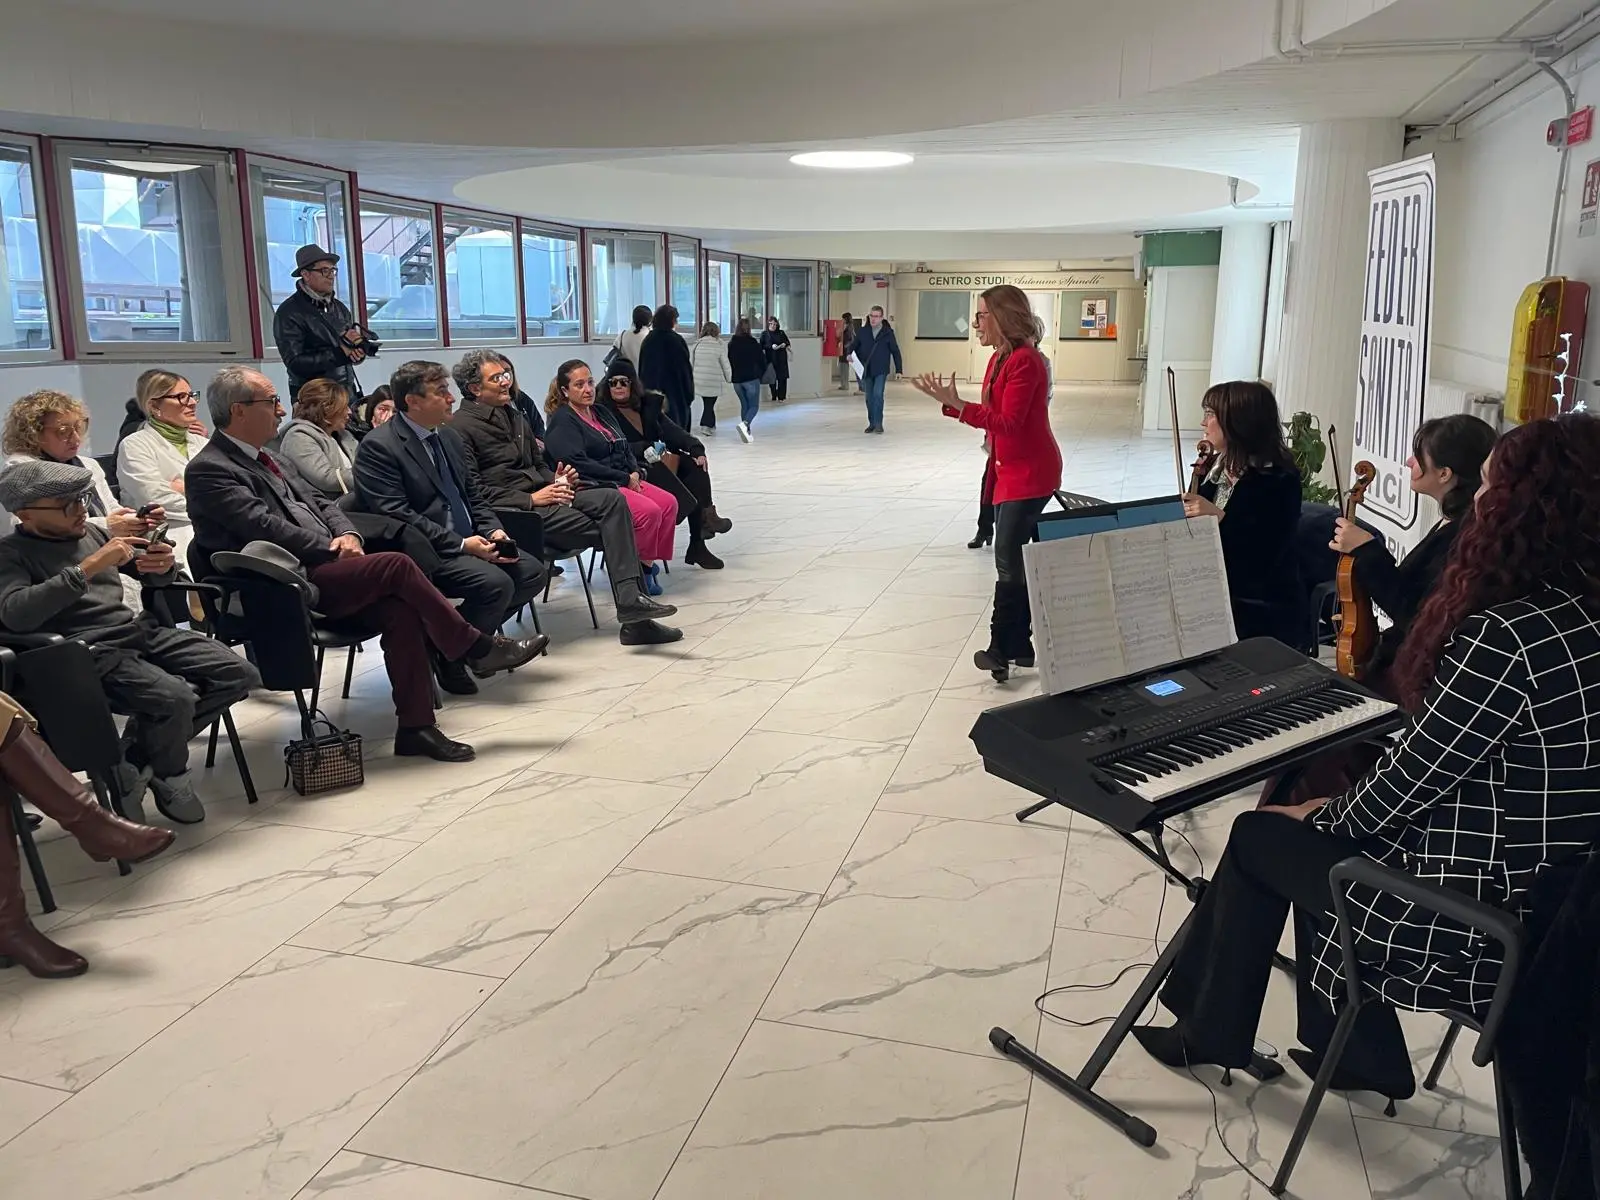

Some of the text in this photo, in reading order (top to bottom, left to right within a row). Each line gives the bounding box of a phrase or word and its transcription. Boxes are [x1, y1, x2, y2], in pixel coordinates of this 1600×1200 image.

[928, 276, 971, 286] CENTRO
[974, 276, 1005, 286] STUDI
[1364, 194, 1421, 327] FEDER
[1357, 467, 1402, 509] nci
